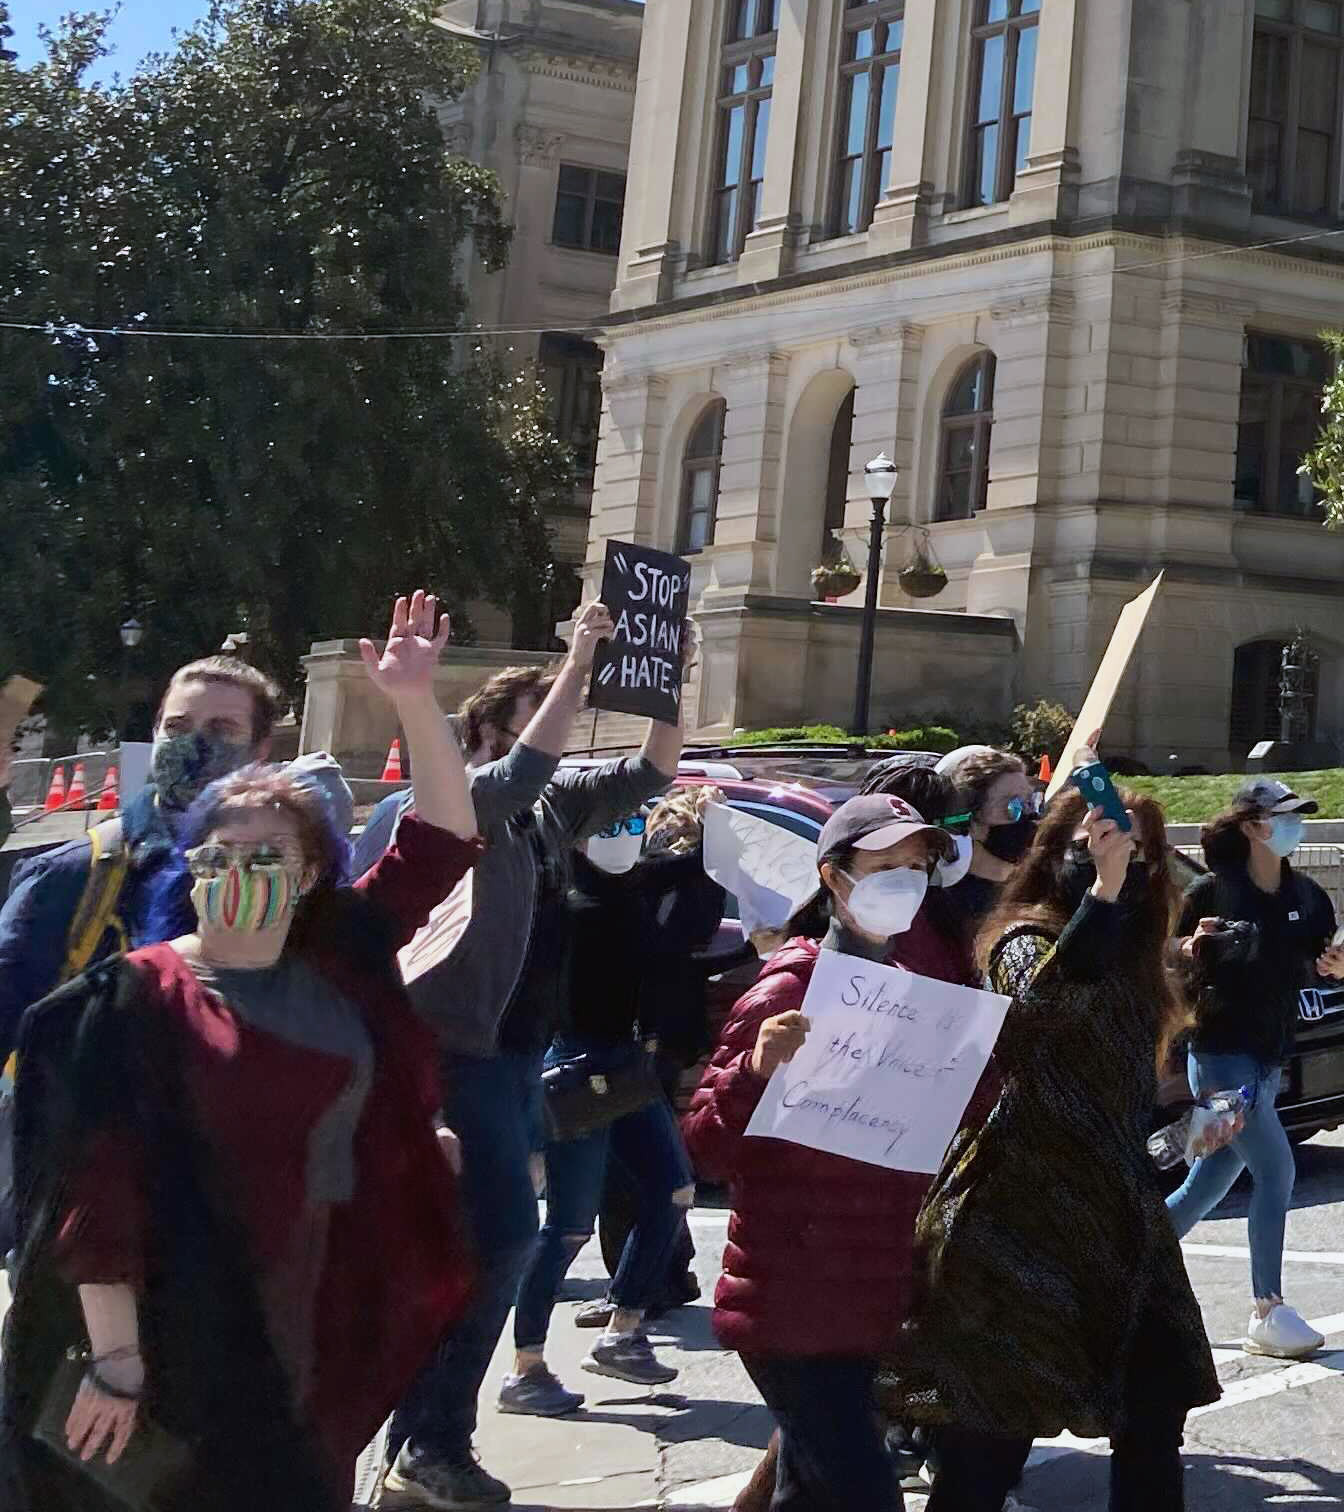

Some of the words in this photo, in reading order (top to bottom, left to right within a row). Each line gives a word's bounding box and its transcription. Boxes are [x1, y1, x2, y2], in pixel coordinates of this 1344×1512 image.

[627, 561, 681, 610] STOP
[612, 609, 681, 656] ASIAN
[620, 655, 673, 694] HATE
[840, 975, 921, 1022] Silence
[830, 1032, 863, 1060] the
